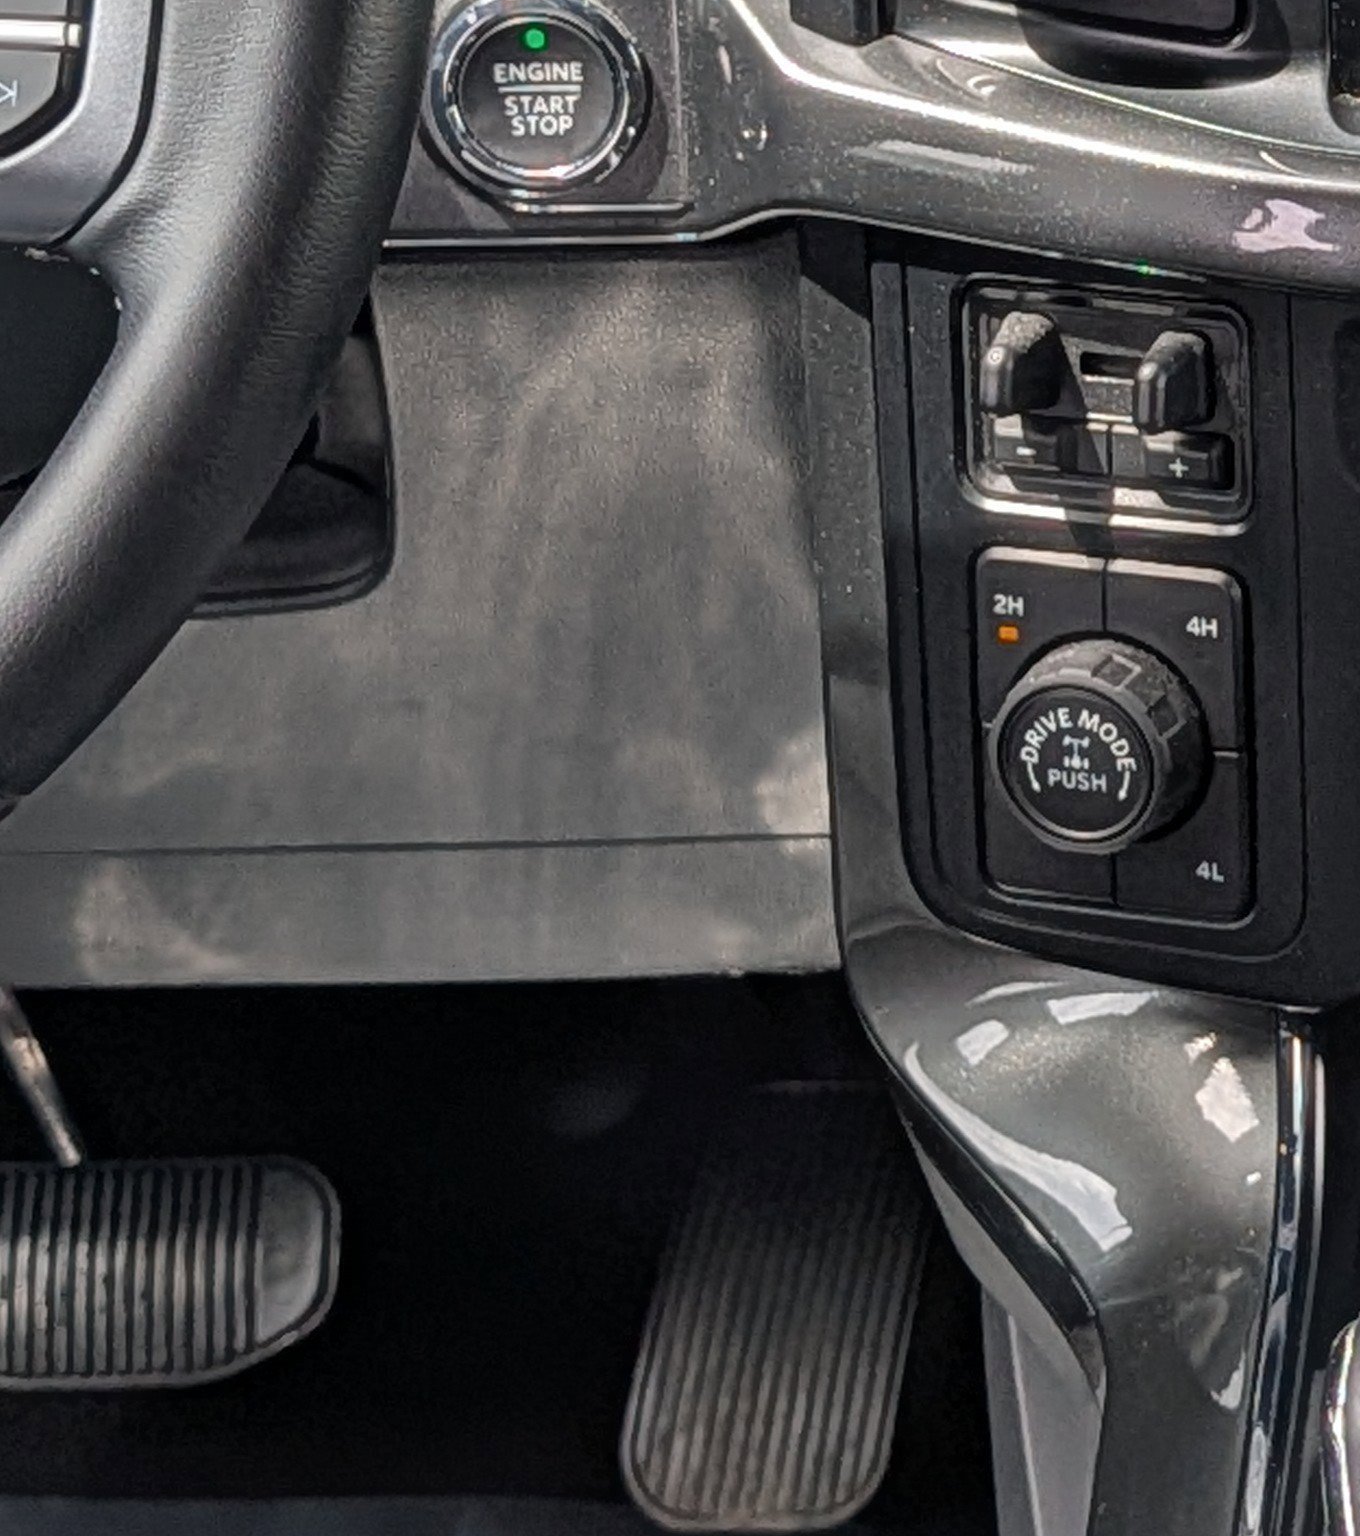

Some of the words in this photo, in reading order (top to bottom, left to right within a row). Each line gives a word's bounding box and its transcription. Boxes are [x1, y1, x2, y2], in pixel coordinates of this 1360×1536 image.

[493, 61, 584, 84] ENGINE
[503, 94, 578, 117] START
[510, 114, 574, 137] STOP
[992, 594, 1025, 617] 2H
[1185, 617, 1218, 640] 4H
[1020, 706, 1074, 765] DRIVE
[1077, 707, 1138, 772] MODE
[1047, 767, 1108, 793] PUSH
[1195, 861, 1225, 883] 4L
